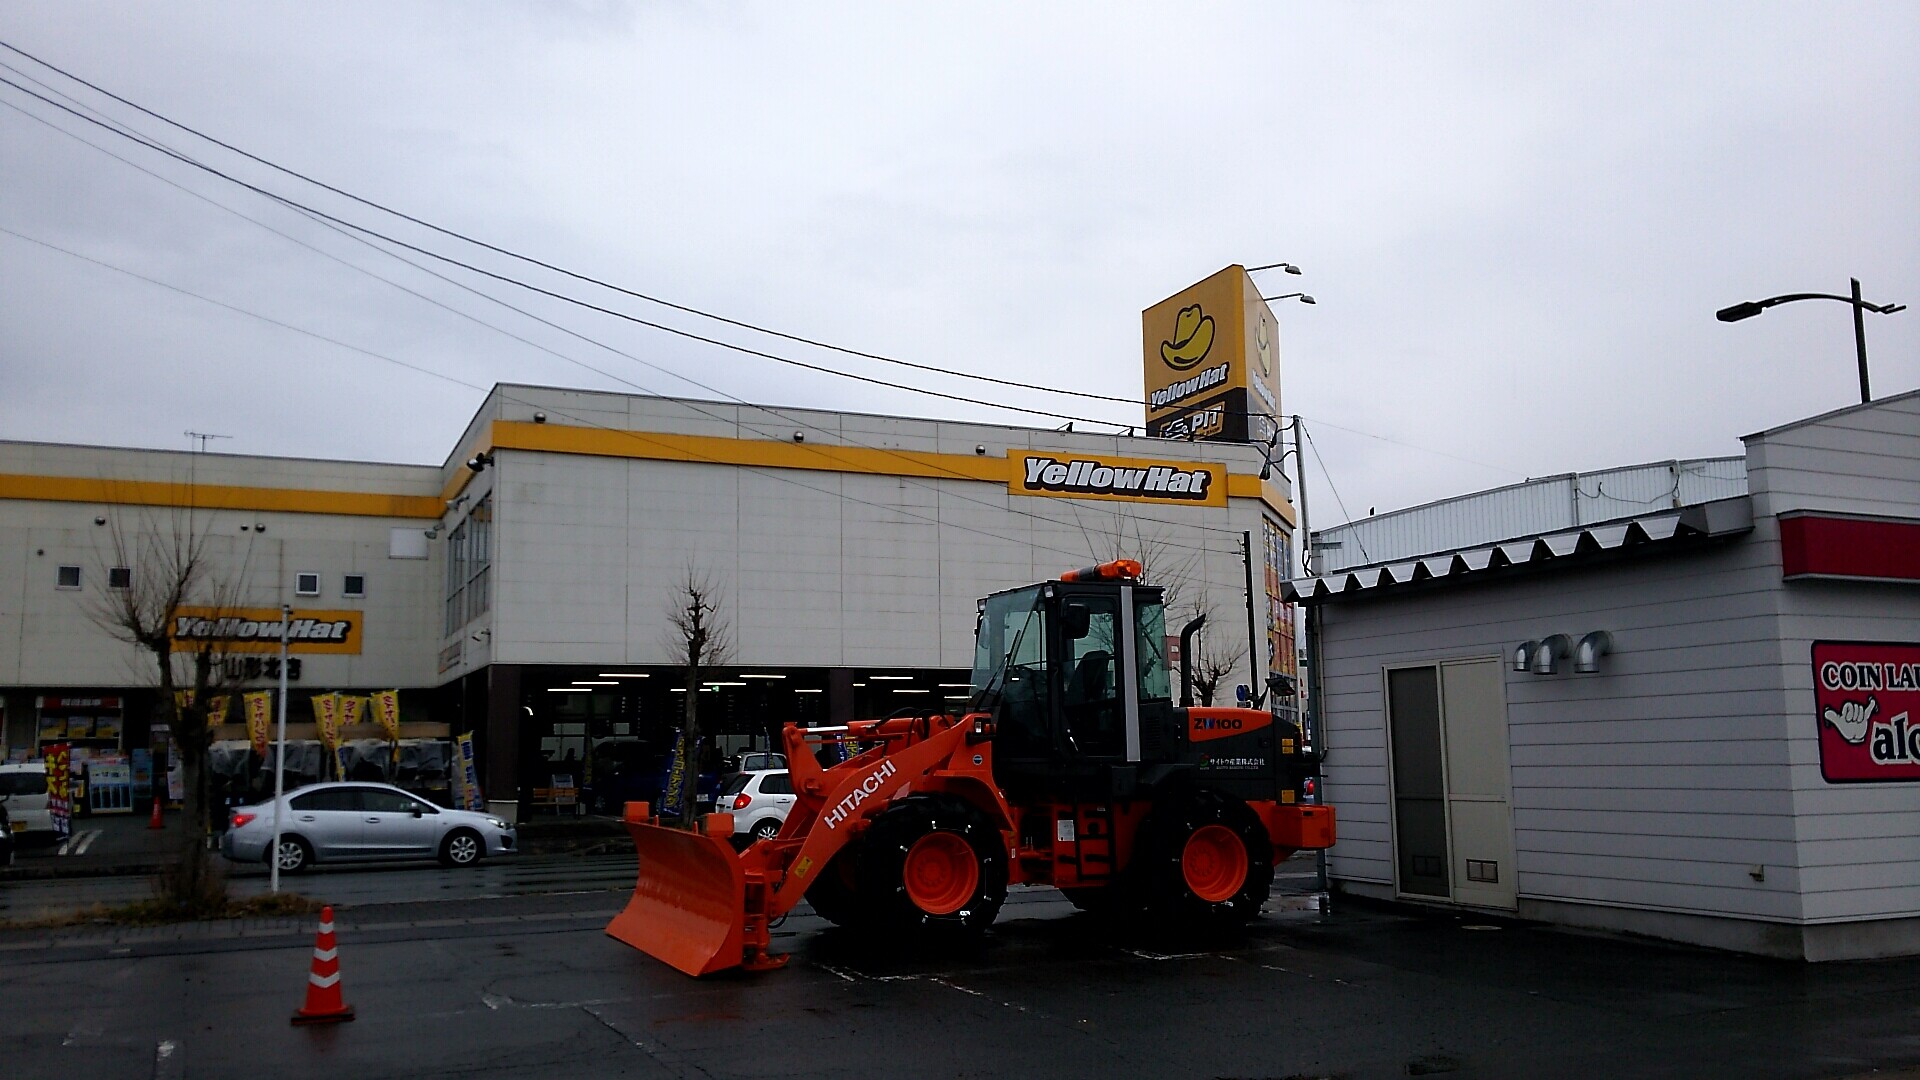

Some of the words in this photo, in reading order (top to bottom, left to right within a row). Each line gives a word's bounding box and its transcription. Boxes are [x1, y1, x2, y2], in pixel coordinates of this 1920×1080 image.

[1150, 362, 1229, 409] YellowHat
[1191, 405, 1223, 432] PIT
[1025, 457, 1209, 497] YellowHat
[175, 616, 349, 641] YellowHat
[1821, 662, 1882, 690] COIN
[1193, 717, 1243, 730] ZW100
[823, 759, 897, 831] HITACHI
